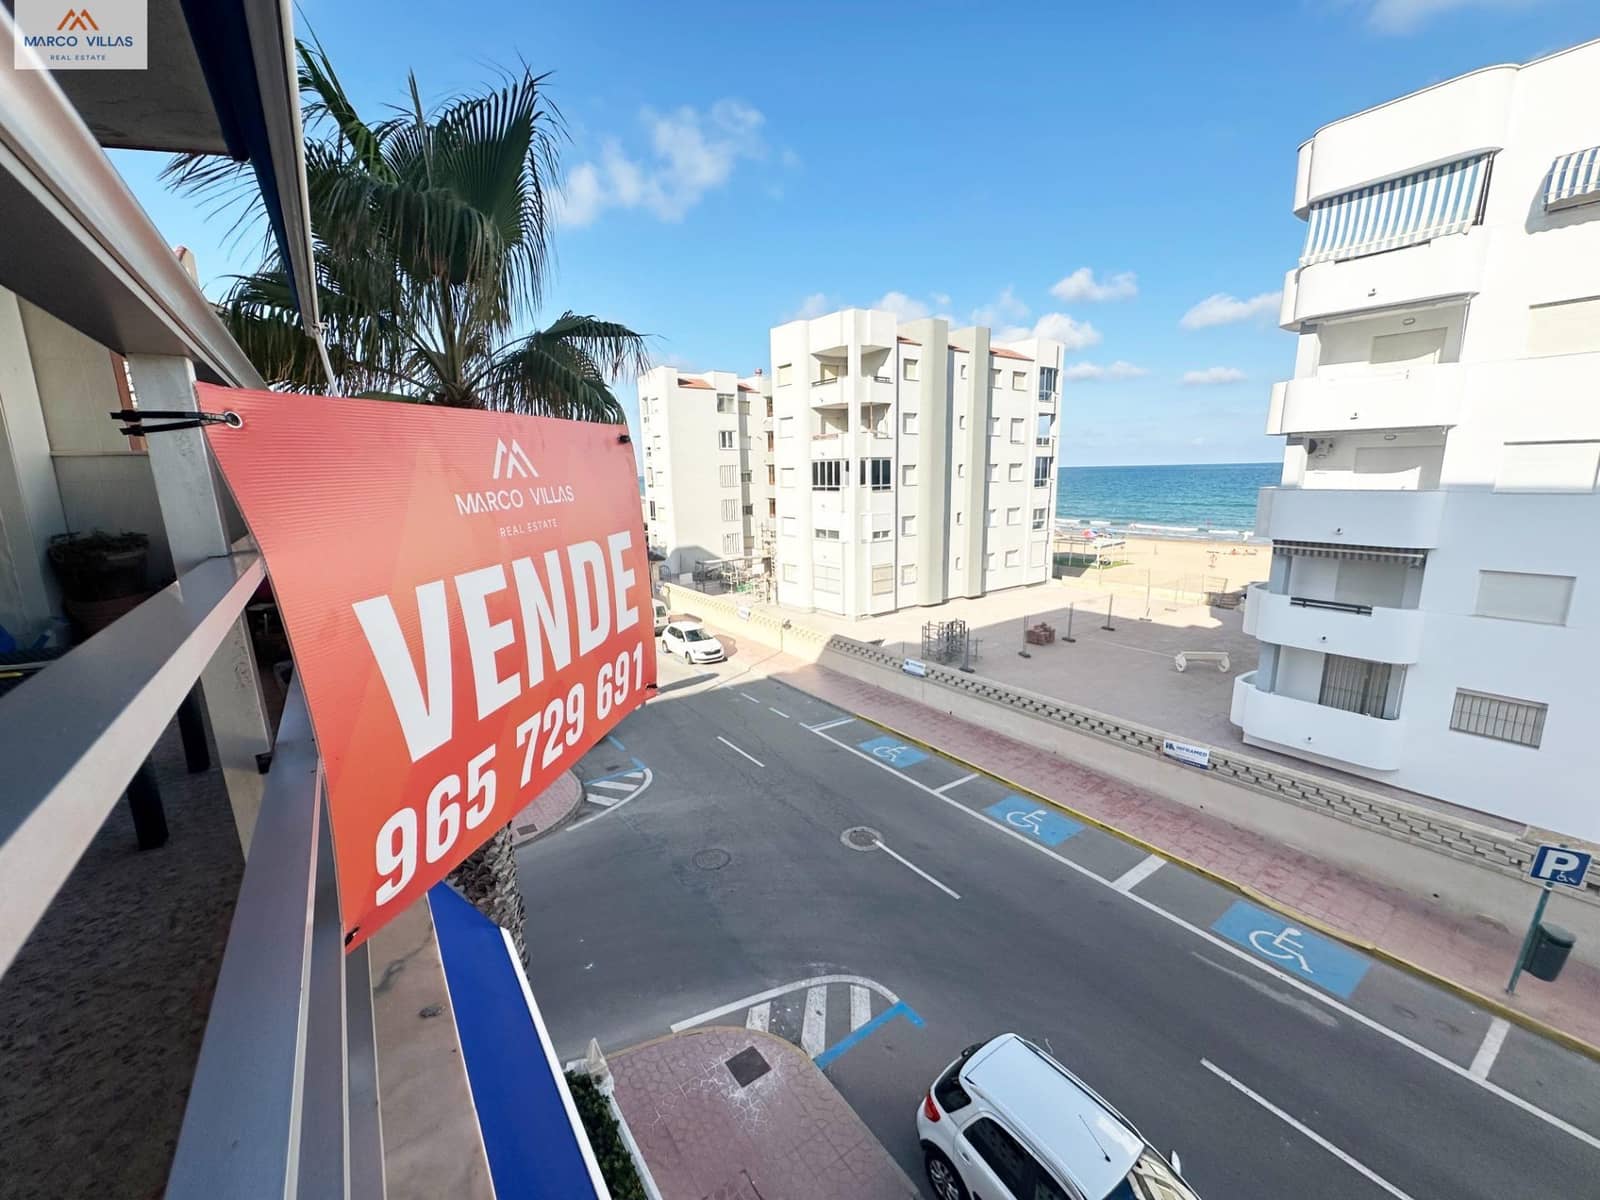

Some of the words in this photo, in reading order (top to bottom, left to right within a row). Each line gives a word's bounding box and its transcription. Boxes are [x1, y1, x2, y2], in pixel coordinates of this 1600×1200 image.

[454, 489, 524, 515] MARCO
[529, 485, 575, 505] VILLAS
[500, 525, 525, 537] REAL
[527, 518, 558, 532] ESTATE
[352, 530, 639, 763] VENDE
[375, 744, 497, 907] 965
[516, 682, 585, 789] 729
[596, 641, 643, 721] 691
[1539, 849, 1580, 879] P
